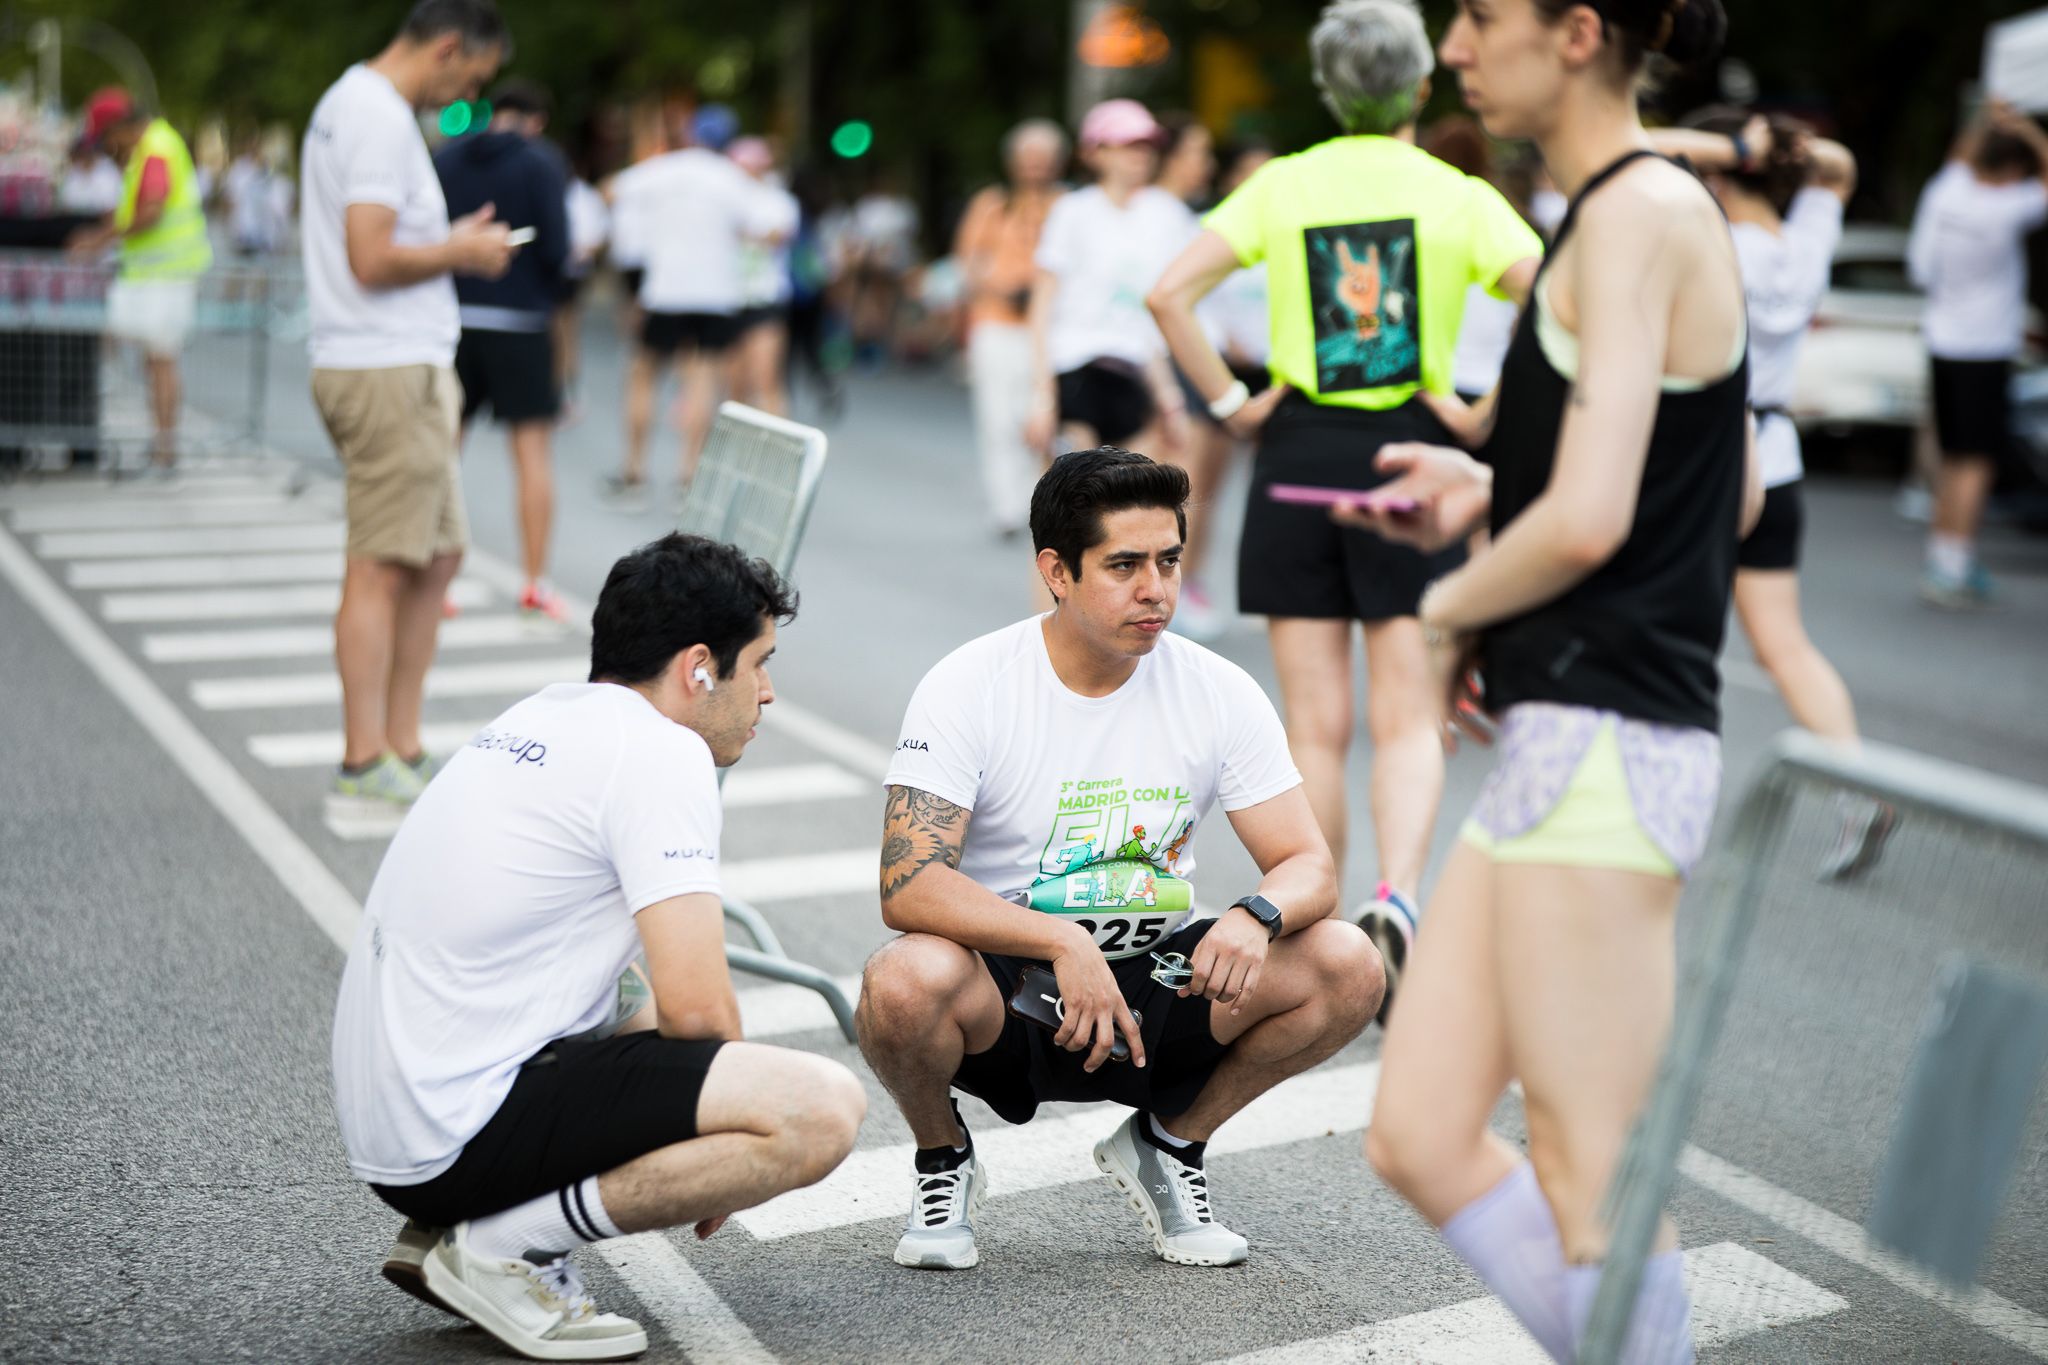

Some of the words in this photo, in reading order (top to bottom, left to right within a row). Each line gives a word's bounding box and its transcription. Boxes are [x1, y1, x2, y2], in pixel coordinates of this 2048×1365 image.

[1077, 777, 1123, 791] Carrera
[1058, 789, 1128, 811] MADRID
[1132, 787, 1169, 802] CON
[1174, 786, 1190, 800] L
[1108, 860, 1129, 869] CON
[1131, 860, 1144, 869] LA
[1062, 868, 1157, 909] ELA
